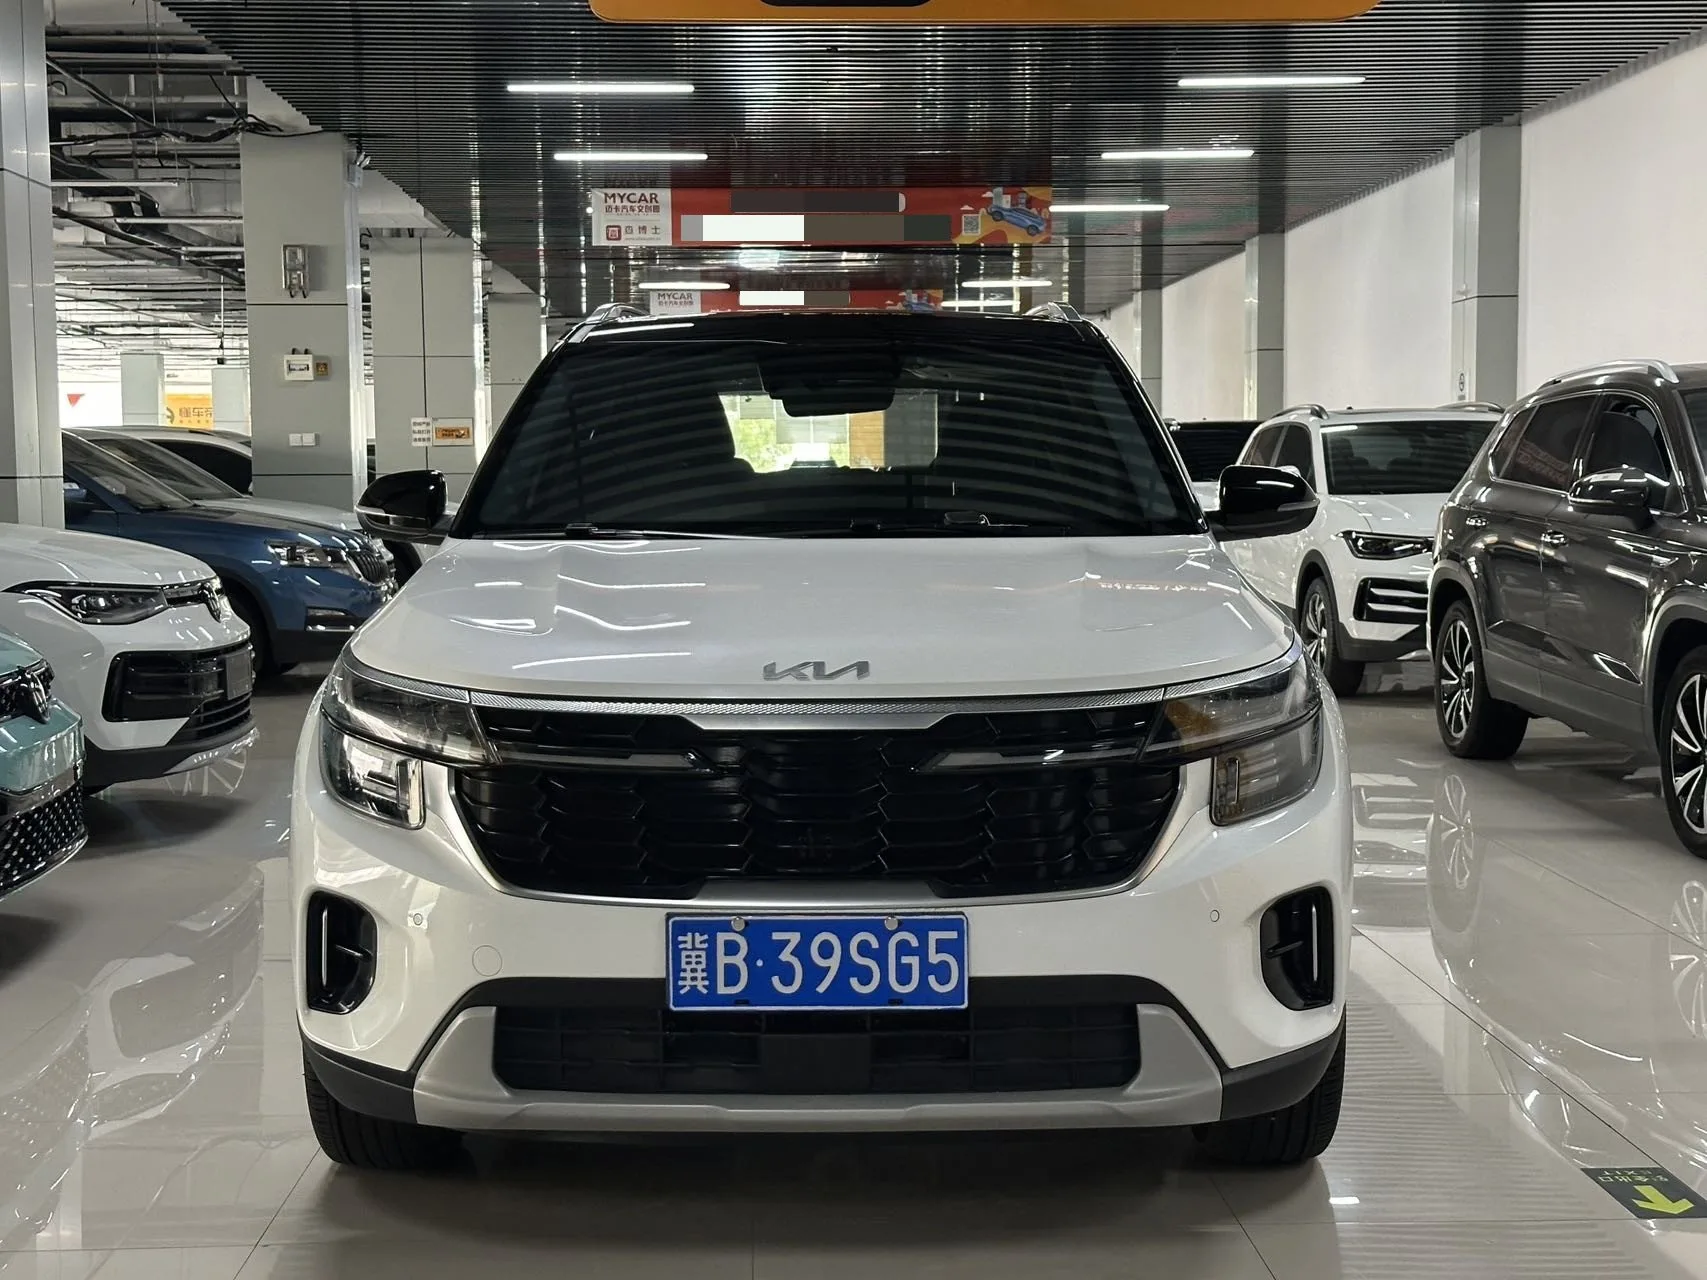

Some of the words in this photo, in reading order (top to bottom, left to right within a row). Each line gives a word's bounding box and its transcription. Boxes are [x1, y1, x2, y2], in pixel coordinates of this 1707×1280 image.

[604, 192, 660, 204] MYCAR
[657, 292, 693, 300] MYCAR
[763, 660, 870, 681] KIA
[677, 930, 960, 995] 冀B·39SG5
